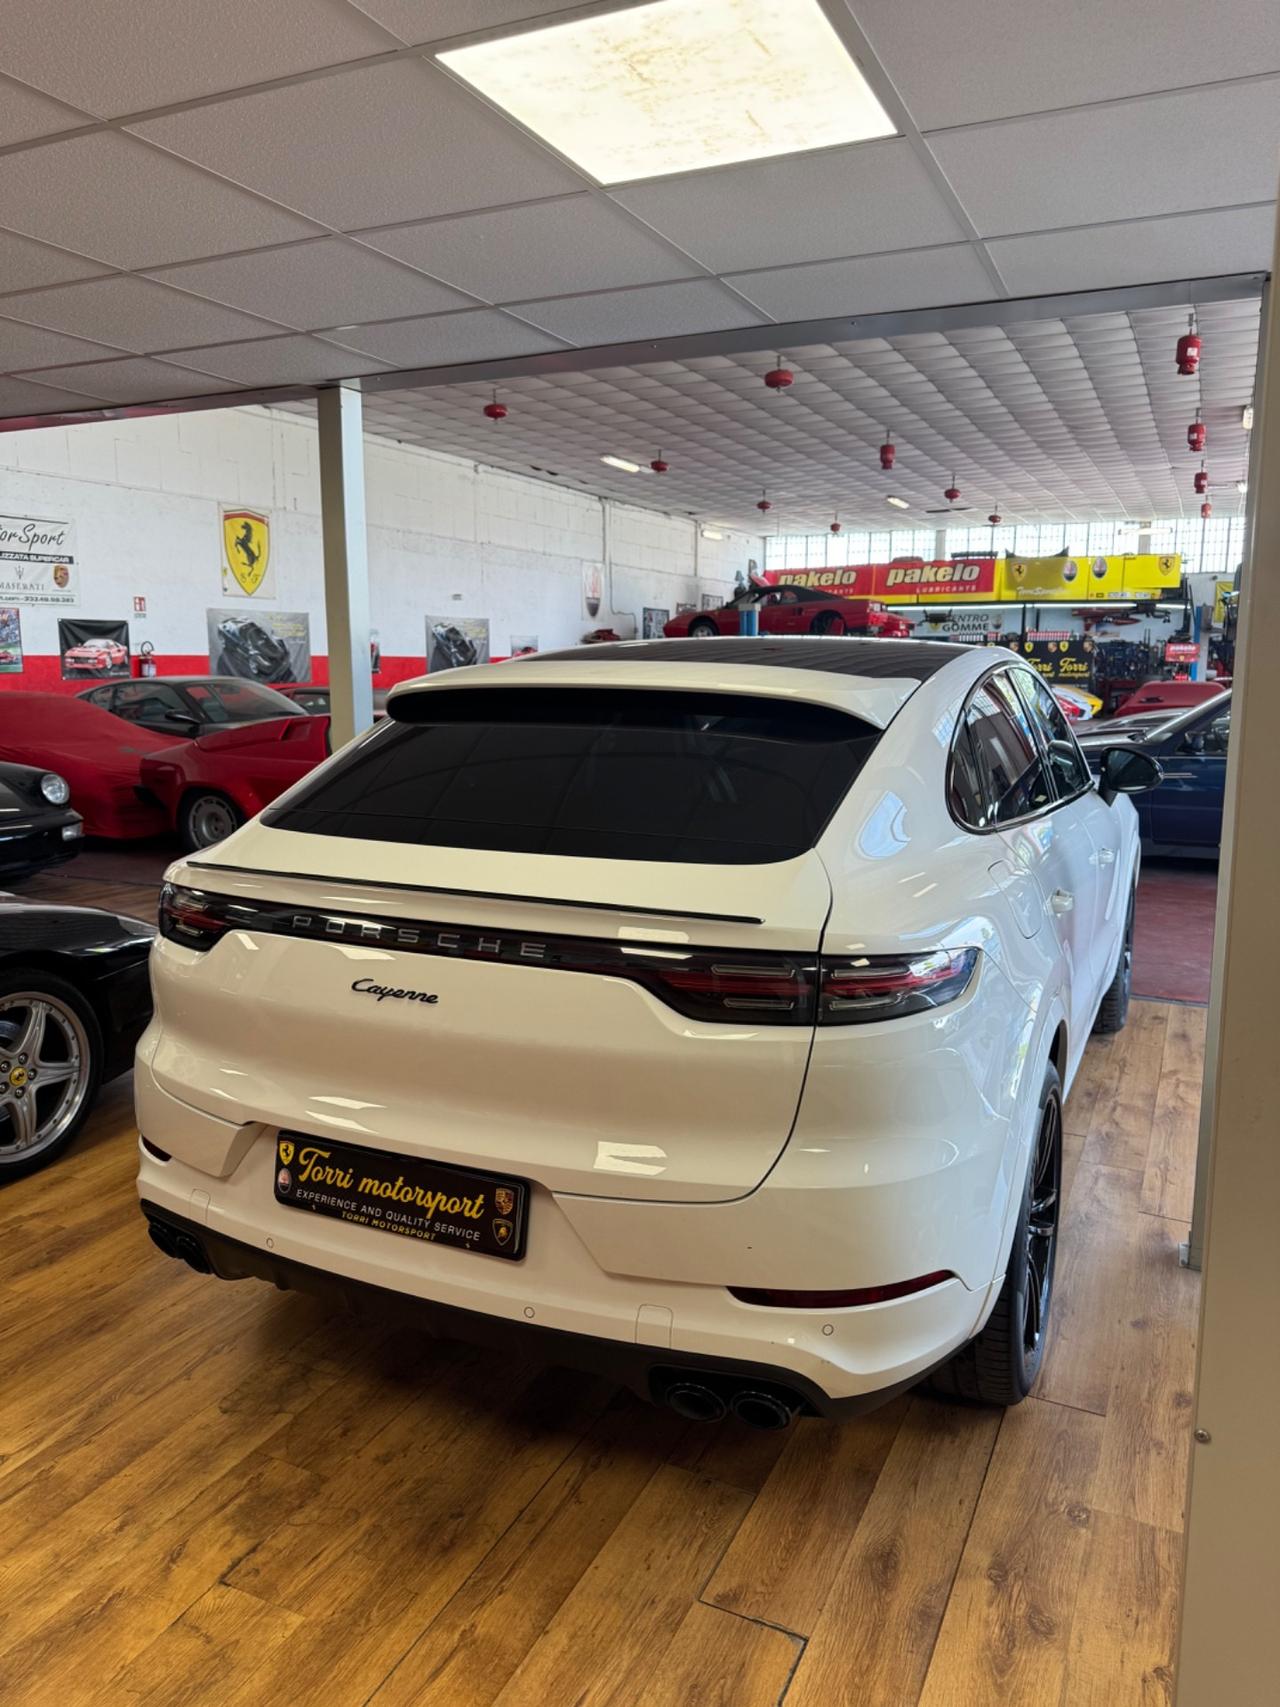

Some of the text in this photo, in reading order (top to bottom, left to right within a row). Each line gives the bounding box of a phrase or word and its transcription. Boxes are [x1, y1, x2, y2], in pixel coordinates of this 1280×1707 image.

[886, 563, 980, 586] pakelo
[916, 585, 976, 593] LUBRICANTS
[942, 623, 989, 632] GOMME
[952, 614, 989, 622] ENTRO
[1059, 657, 1088, 672] Torri
[291, 915, 547, 958] PORSCHE
[352, 978, 439, 1005] Cayenne
[298, 1147, 485, 1219] Torri motorsport
[296, 1189, 481, 1241] EXPERIENCE AND QUALITY SERVICE
[341, 1211, 436, 1241] TORRI MOTORSPORT
